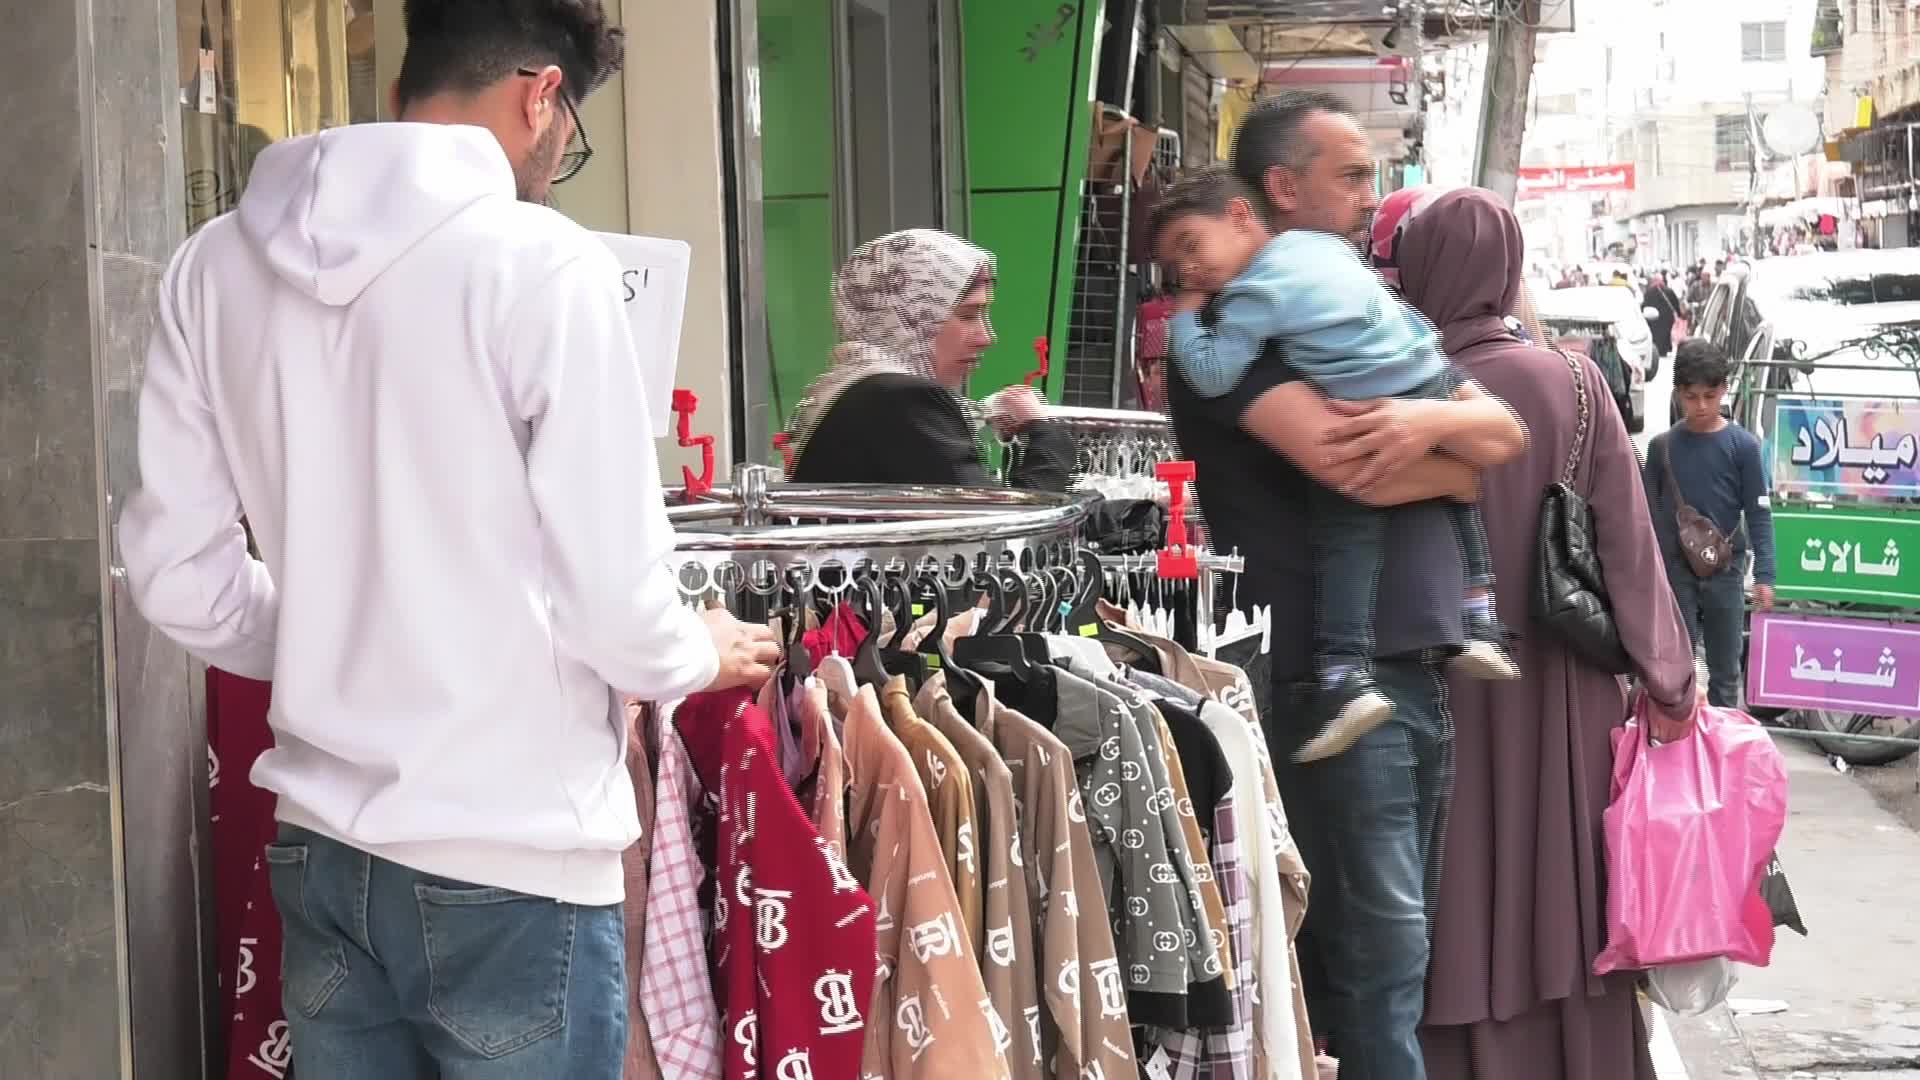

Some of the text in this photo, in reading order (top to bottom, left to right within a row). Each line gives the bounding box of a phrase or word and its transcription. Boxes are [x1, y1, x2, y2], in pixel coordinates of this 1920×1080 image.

[1791, 414, 1918, 484] ميلاد
[1800, 538, 1900, 576] شالات
[1790, 644, 1897, 688] شنط
